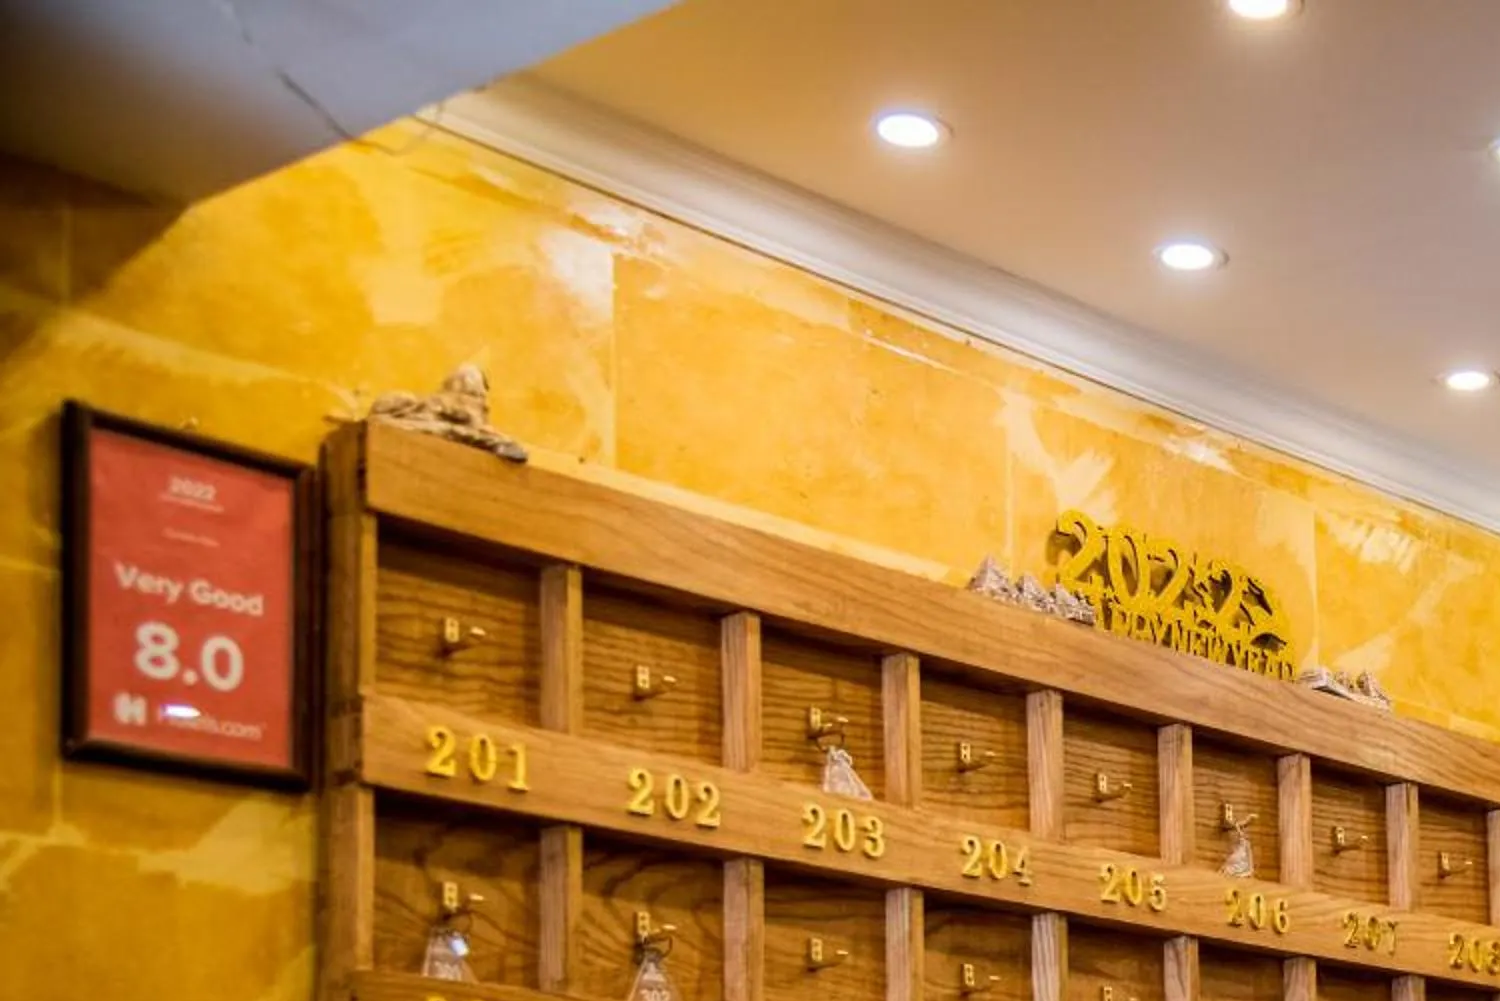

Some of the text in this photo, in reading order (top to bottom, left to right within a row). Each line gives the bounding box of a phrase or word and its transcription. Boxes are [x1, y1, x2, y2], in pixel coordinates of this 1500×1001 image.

[114, 560, 265, 617] Very Good
[134, 621, 244, 691] 8.0
[425, 725, 529, 792] 201
[627, 767, 721, 827] 202
[802, 803, 886, 859] 203
[959, 835, 1033, 887] 204
[1100, 863, 1166, 911] 205
[1225, 888, 1289, 934] 206
[1343, 910, 1398, 955] 207
